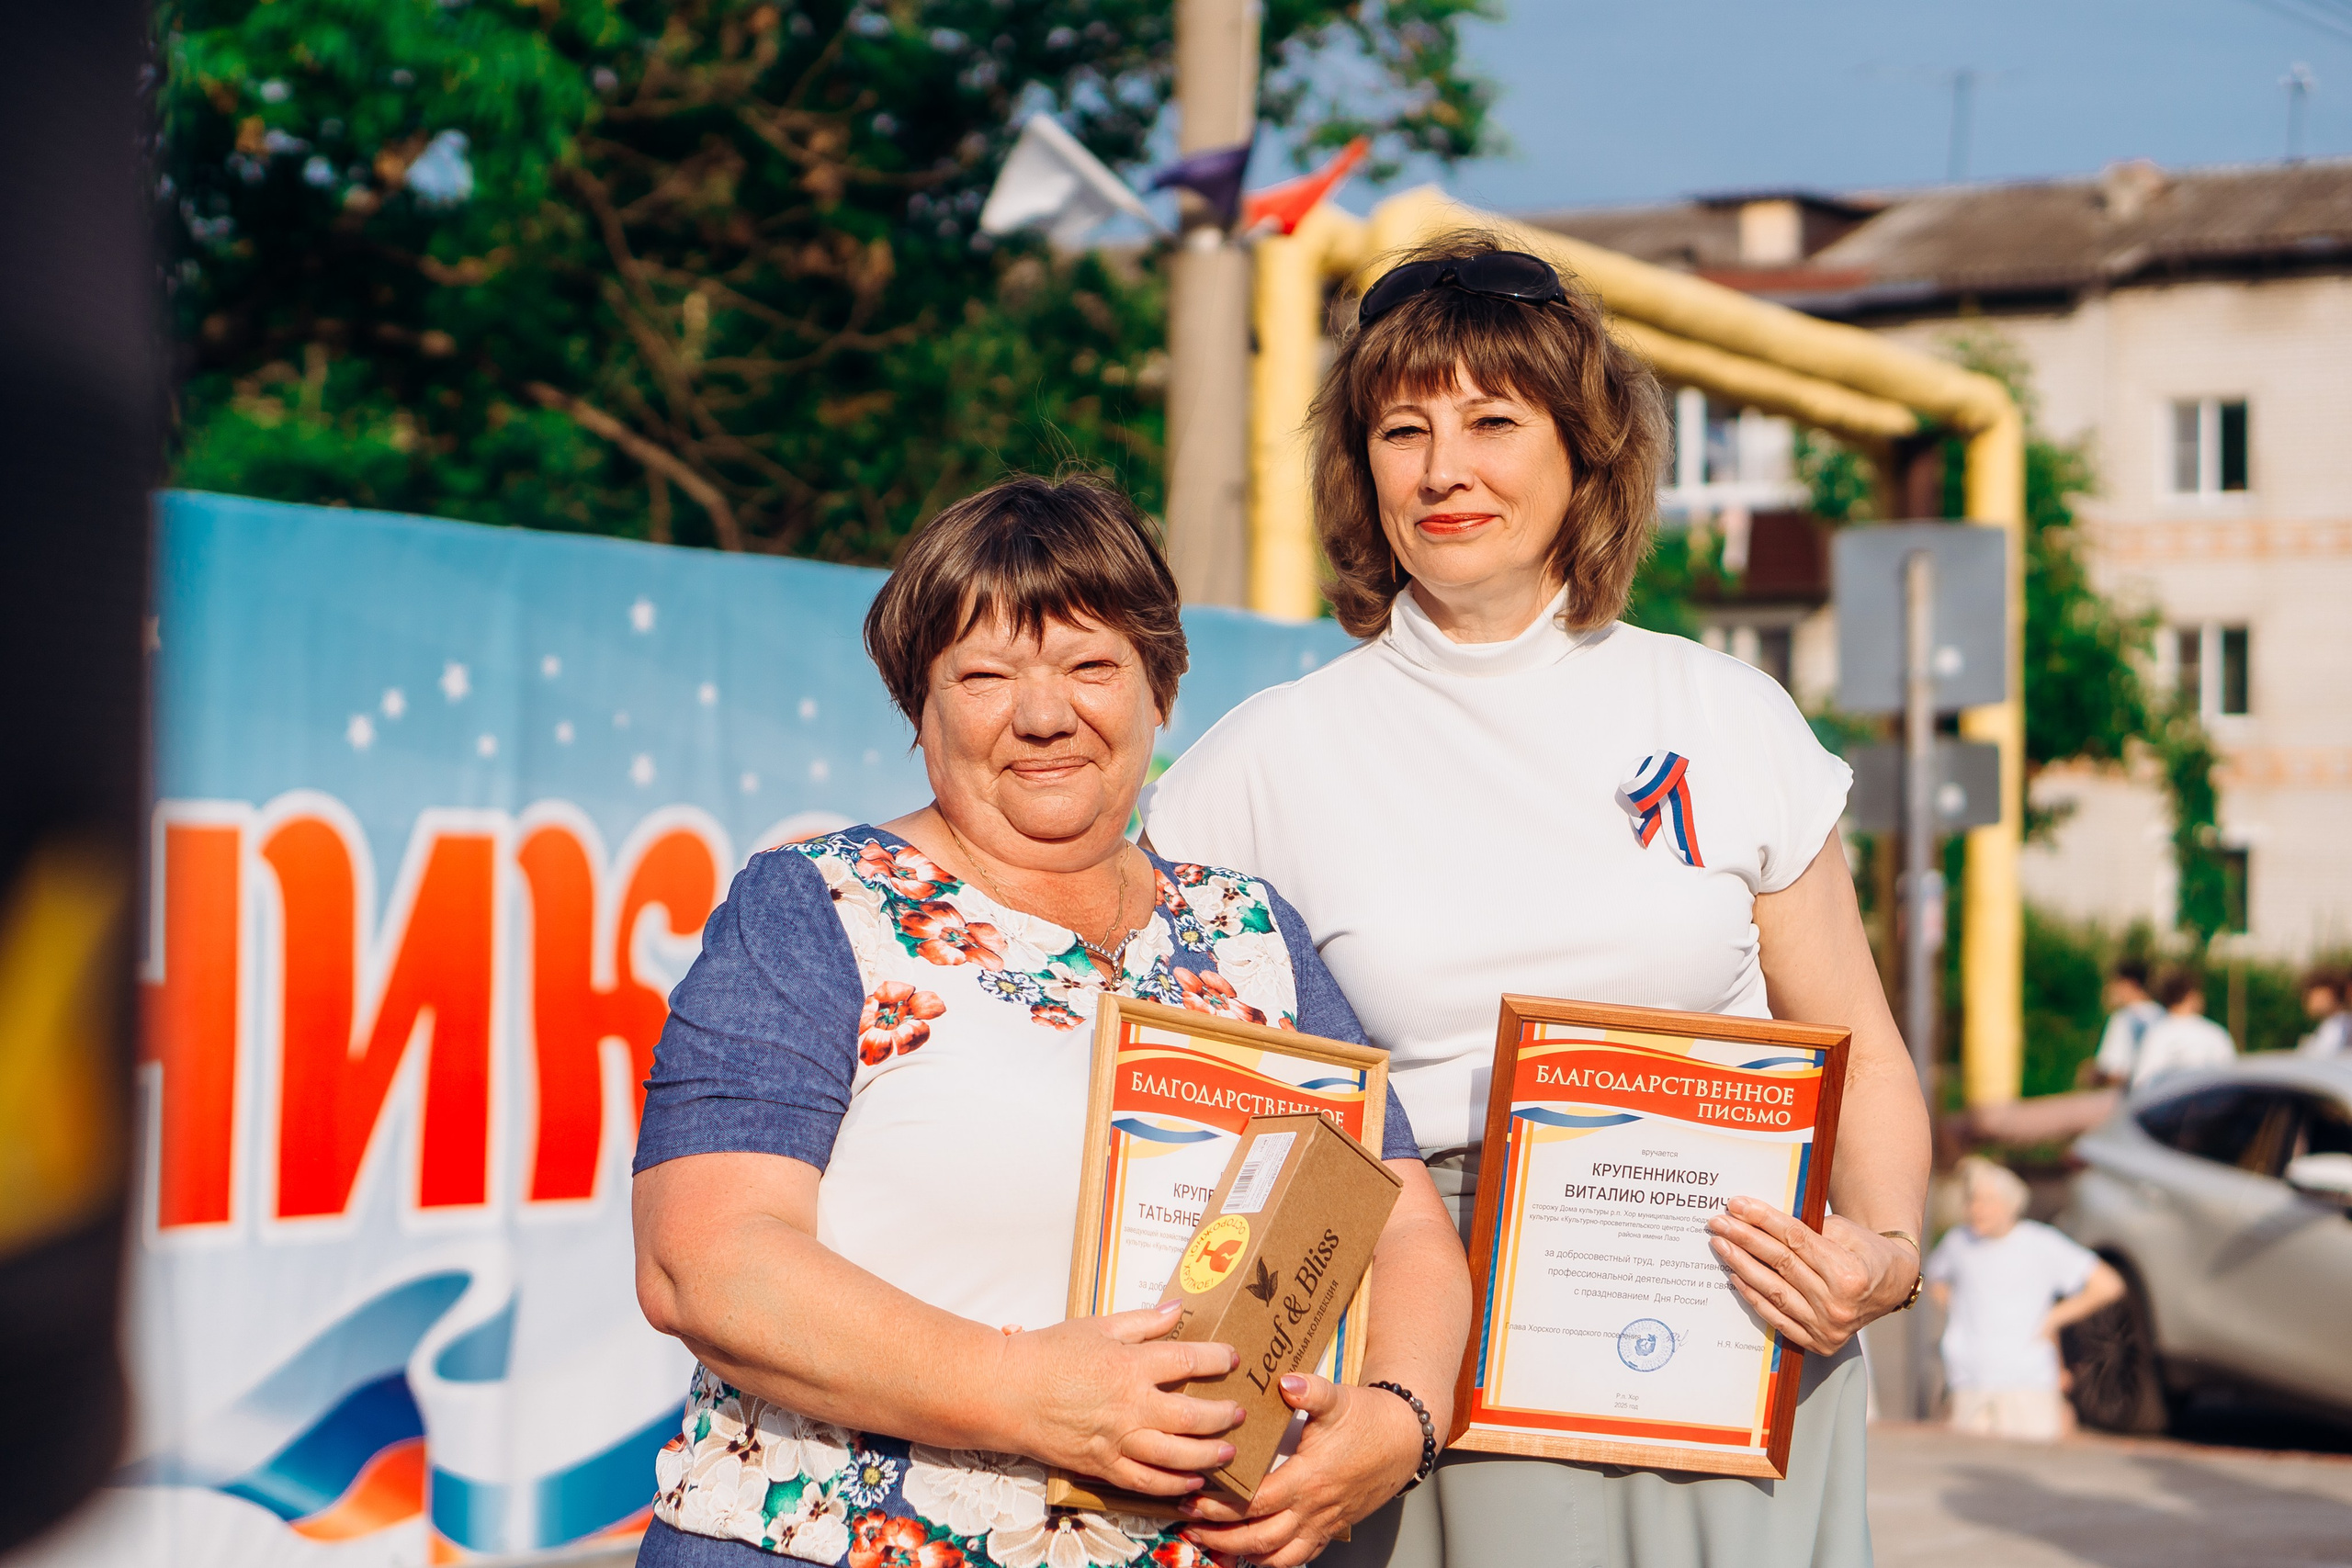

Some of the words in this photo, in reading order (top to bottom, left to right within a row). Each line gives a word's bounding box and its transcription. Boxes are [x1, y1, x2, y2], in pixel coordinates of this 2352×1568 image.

[1535, 1065, 1794, 1106] БЛАГОДАРСТВЕННОЕ
[1697, 1102, 1792, 1126] ПИСЬМО
[1641, 1148, 1679, 1158] вручается
[1591, 1162, 1719, 1186] КРУПЕННИКОВУ
[1565, 1184, 1645, 1203] ВИТАЛИЮ
[1649, 1191, 1730, 1212] ЮРЬЕВИЧ
[1138, 1202, 1201, 1227] ТАТЬЯНЕ
[1529, 1213, 1559, 1222] культуры
[1661, 1224, 1685, 1233] центра
[1532, 1203, 1558, 1212] сторожу
[1559, 1204, 1577, 1213] Дома
[1578, 1207, 1609, 1216] культуры
[1623, 1210, 1636, 1218] Хор
[1637, 1213, 1690, 1222] муниципального
[1617, 1231, 1641, 1239] района
[1663, 1234, 1680, 1242] Лазо
[1295, 1228, 1340, 1299] Bliss
[1544, 1249, 1555, 1258] за
[1556, 1249, 1631, 1264] добросовестный
[1547, 1268, 1634, 1281] профессиональной
[1634, 1275, 1696, 1287] деятельности
[1283, 1293, 1311, 1325] &
[1307, 1280, 1340, 1338] КОЛЛЕКЦИЯ
[1581, 1288, 1650, 1301] празднованием
[1653, 1292, 1671, 1303] Дня
[1673, 1294, 1709, 1306] России!
[1505, 1322, 1527, 1331] Глава
[1528, 1324, 1561, 1334] Хорского
[1562, 1328, 1601, 1337] городского
[1603, 1331, 1642, 1340] поселения
[1246, 1314, 1294, 1395] Leaf
